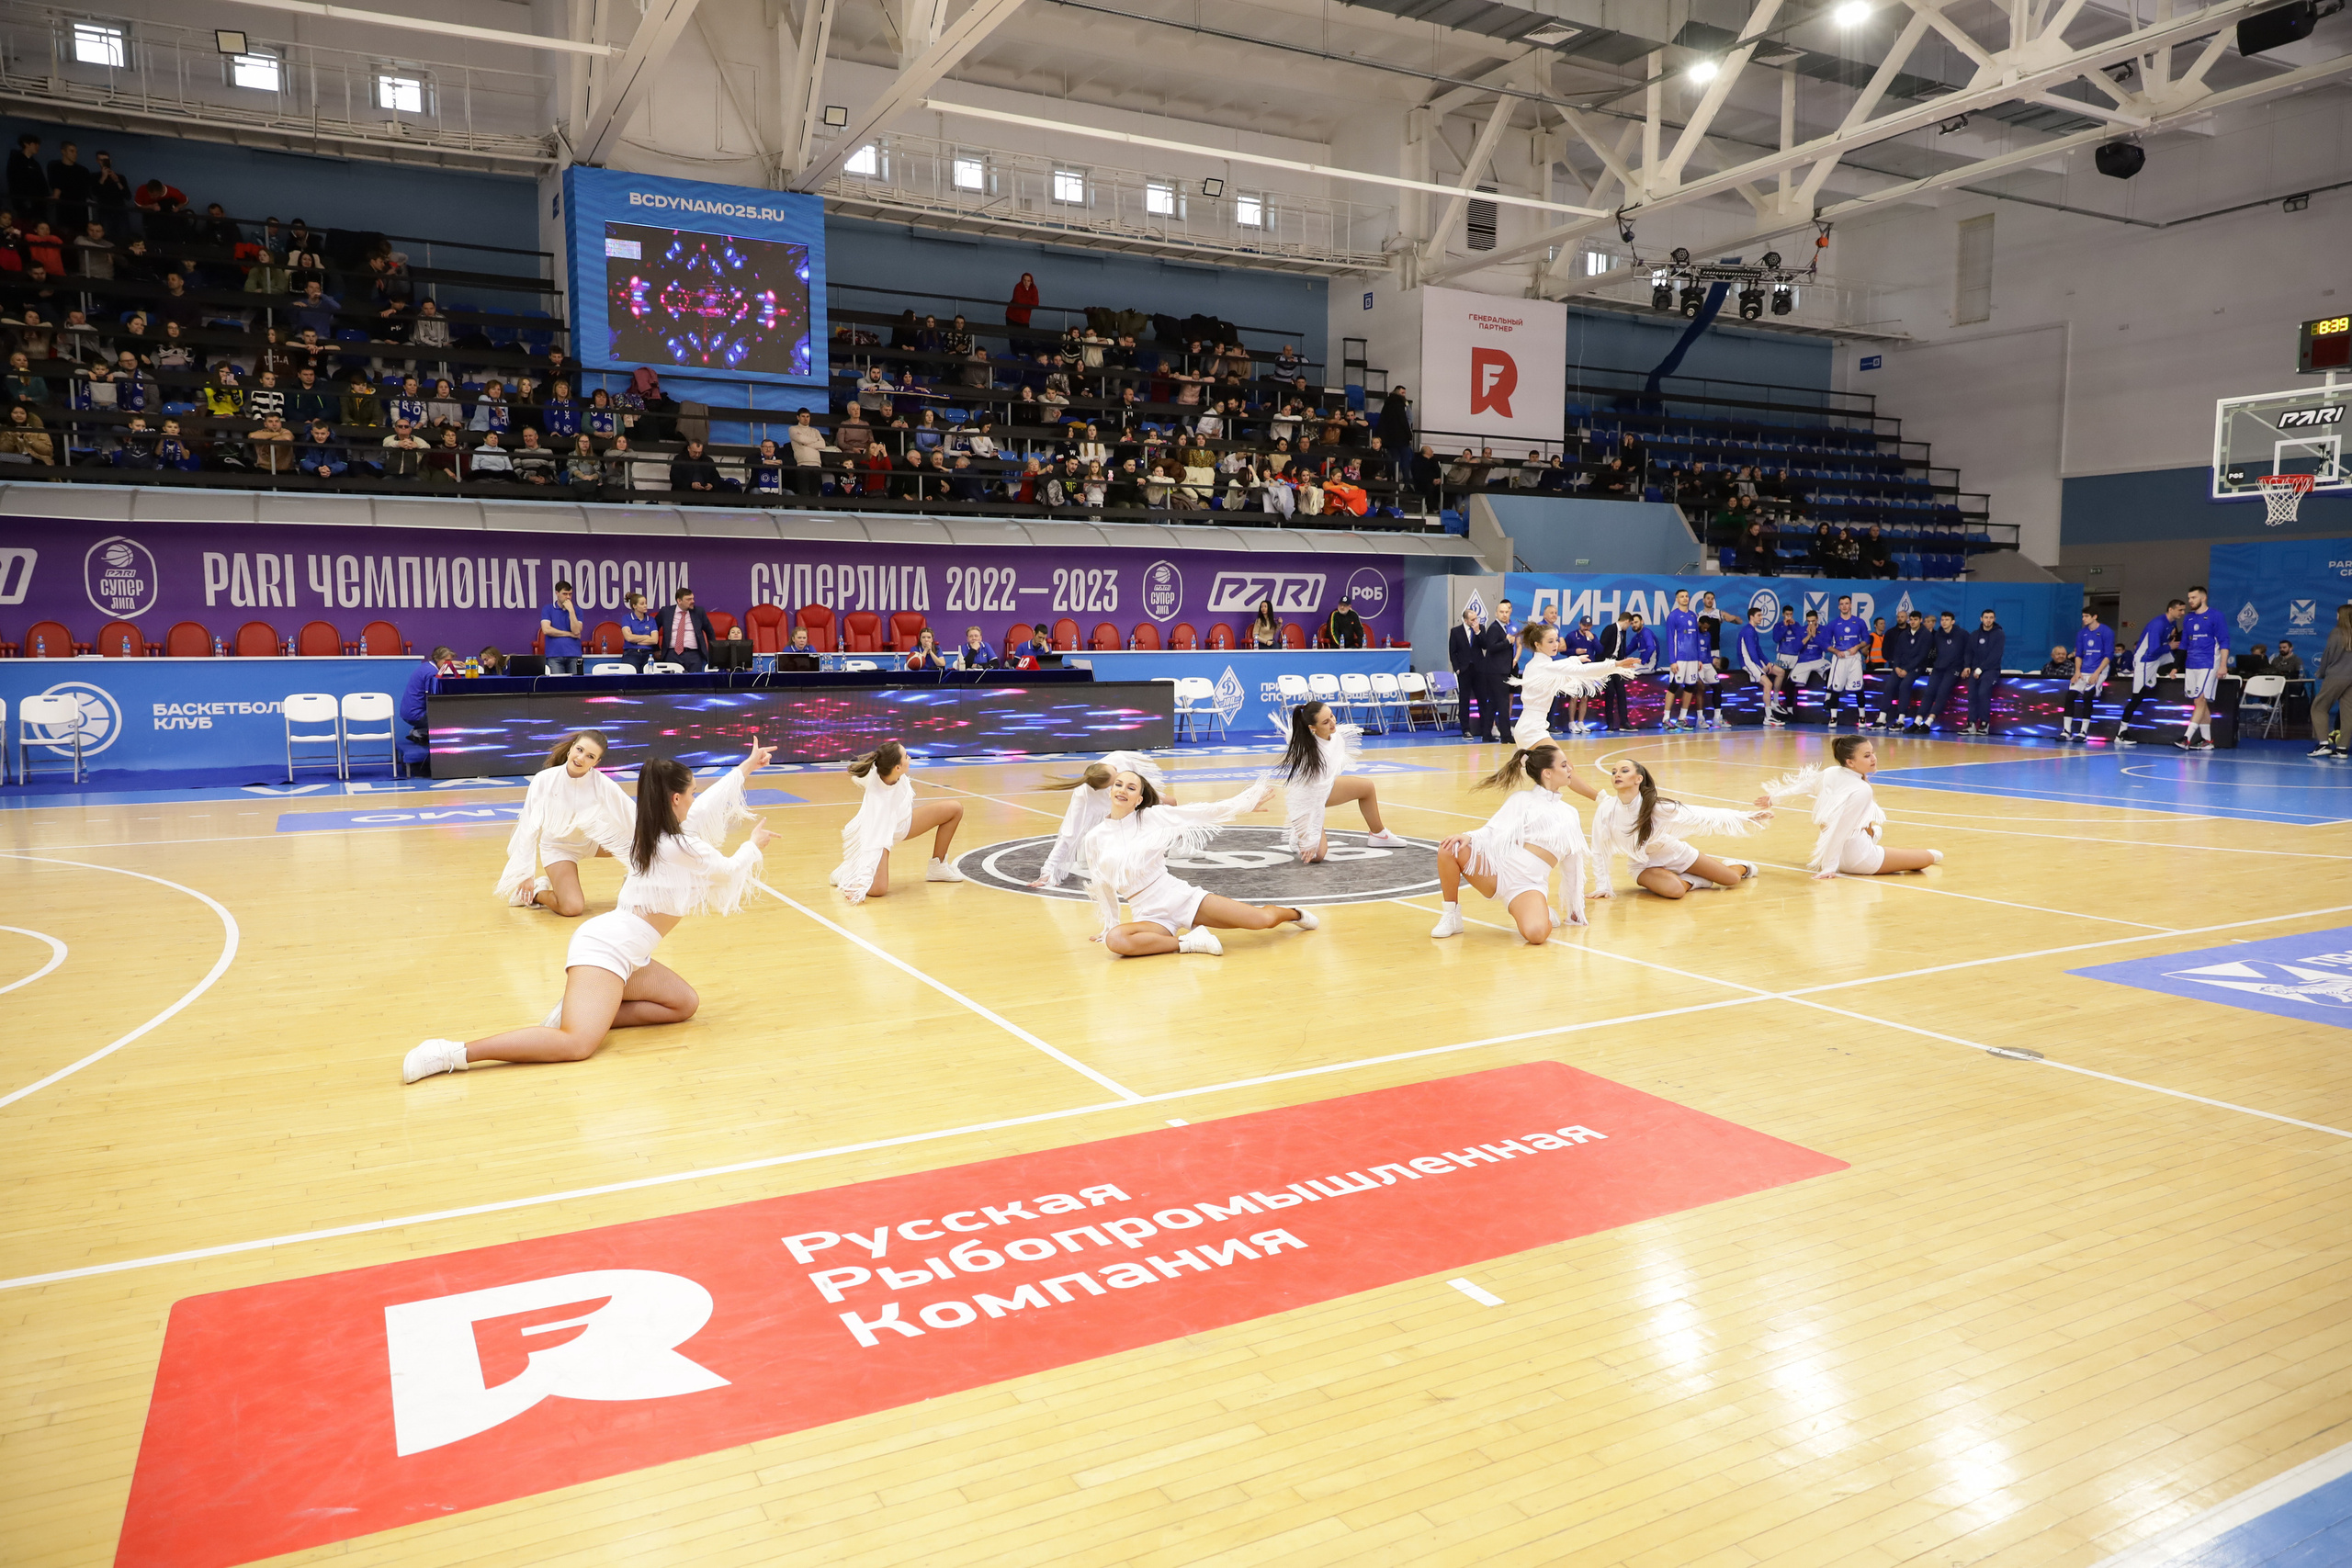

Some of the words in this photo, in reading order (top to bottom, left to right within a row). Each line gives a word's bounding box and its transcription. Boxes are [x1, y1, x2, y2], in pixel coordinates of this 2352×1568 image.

[629, 192, 785, 222] BCDYNAMO25.RU
[1468, 313, 1523, 327] ГЕНЕРАЛЬНЫЙ
[1478, 322, 1513, 333] ПАРТНЕР
[2278, 406, 2344, 428] PARI
[100, 579, 144, 596] СУПЕР
[203, 551, 296, 608] PARI
[552, 558, 688, 610] РОССИИ
[1150, 592, 1175, 605] СУПЕР
[1213, 578, 1321, 607] PARI
[1351, 586, 1383, 600] РФБ
[111, 597, 135, 609] ЛИГА
[153, 701, 288, 716] БАСКЕТБОЛ
[153, 717, 212, 729] КЛУБ
[808, 1119, 1610, 1304] Рыбопромышленная
[781, 1182, 1132, 1265] Русская
[839, 1228, 1309, 1348] Компания
